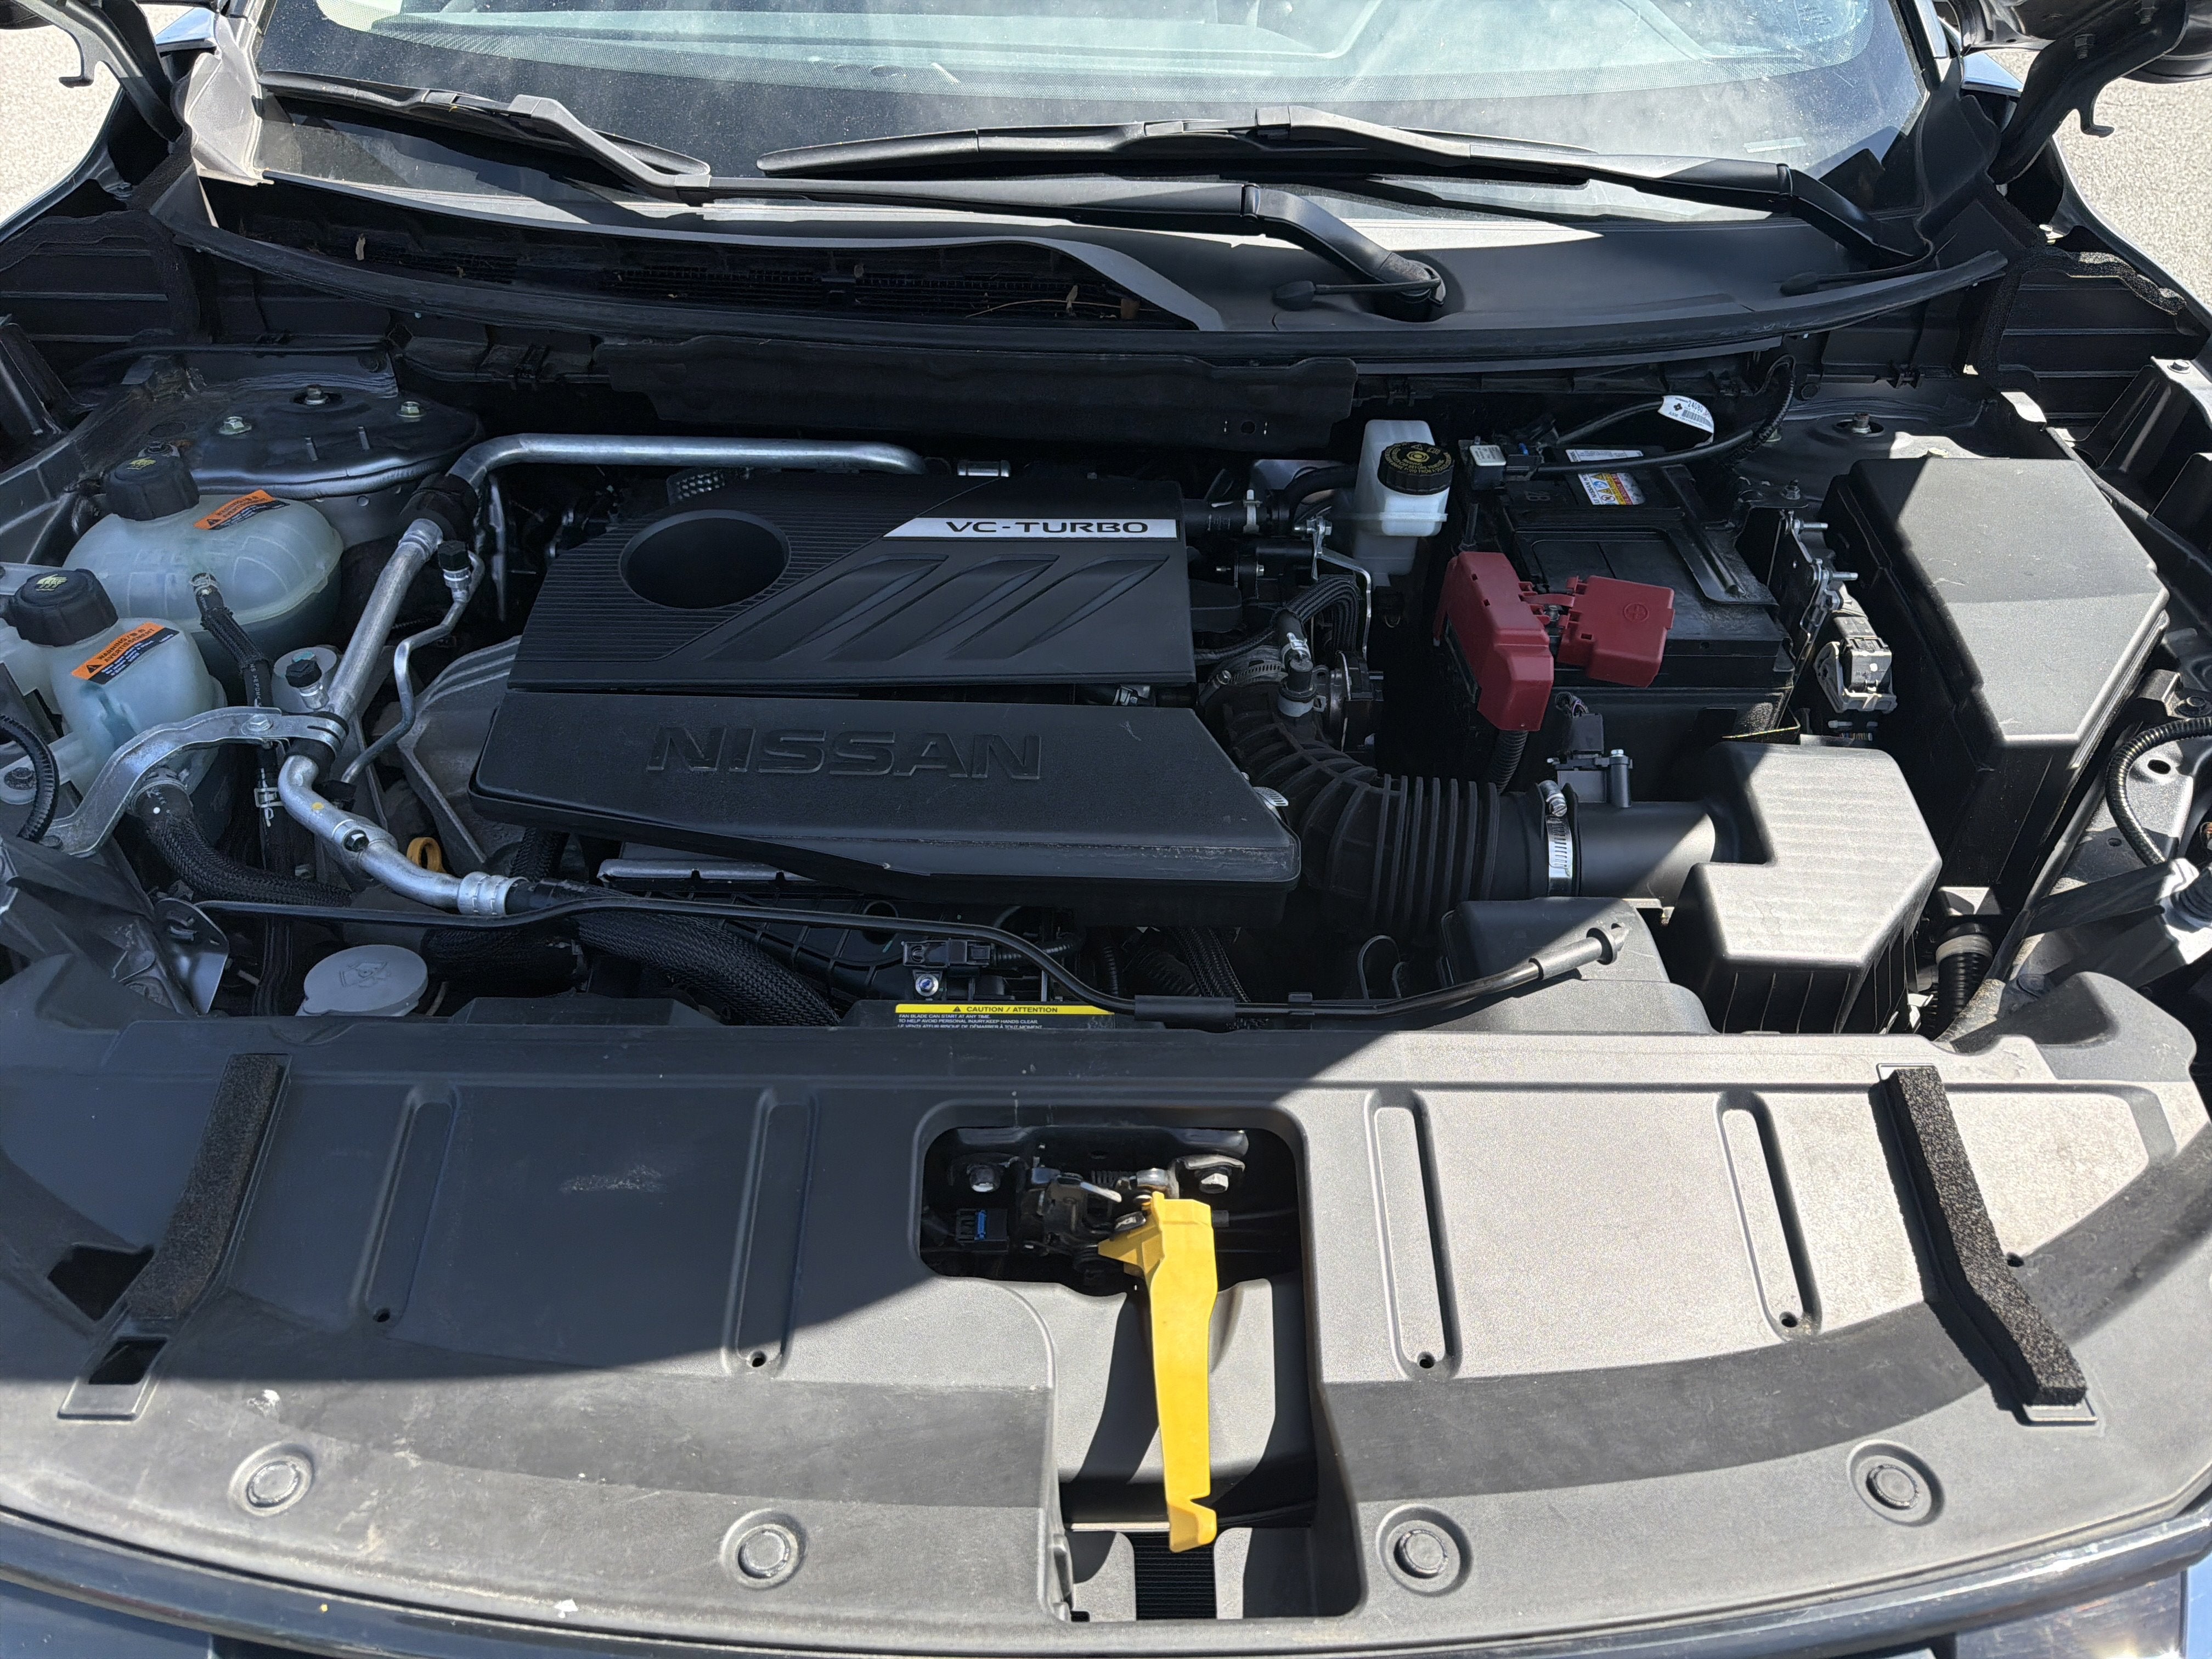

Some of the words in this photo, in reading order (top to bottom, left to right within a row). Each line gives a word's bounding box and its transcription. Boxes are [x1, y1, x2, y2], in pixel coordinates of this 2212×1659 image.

[946, 521, 1149, 533] VC-TURBO
[97, 637, 128, 660] WARNING
[104, 628, 155, 663] AVERTISSEMENT
[646, 726, 1042, 780] NISSAN
